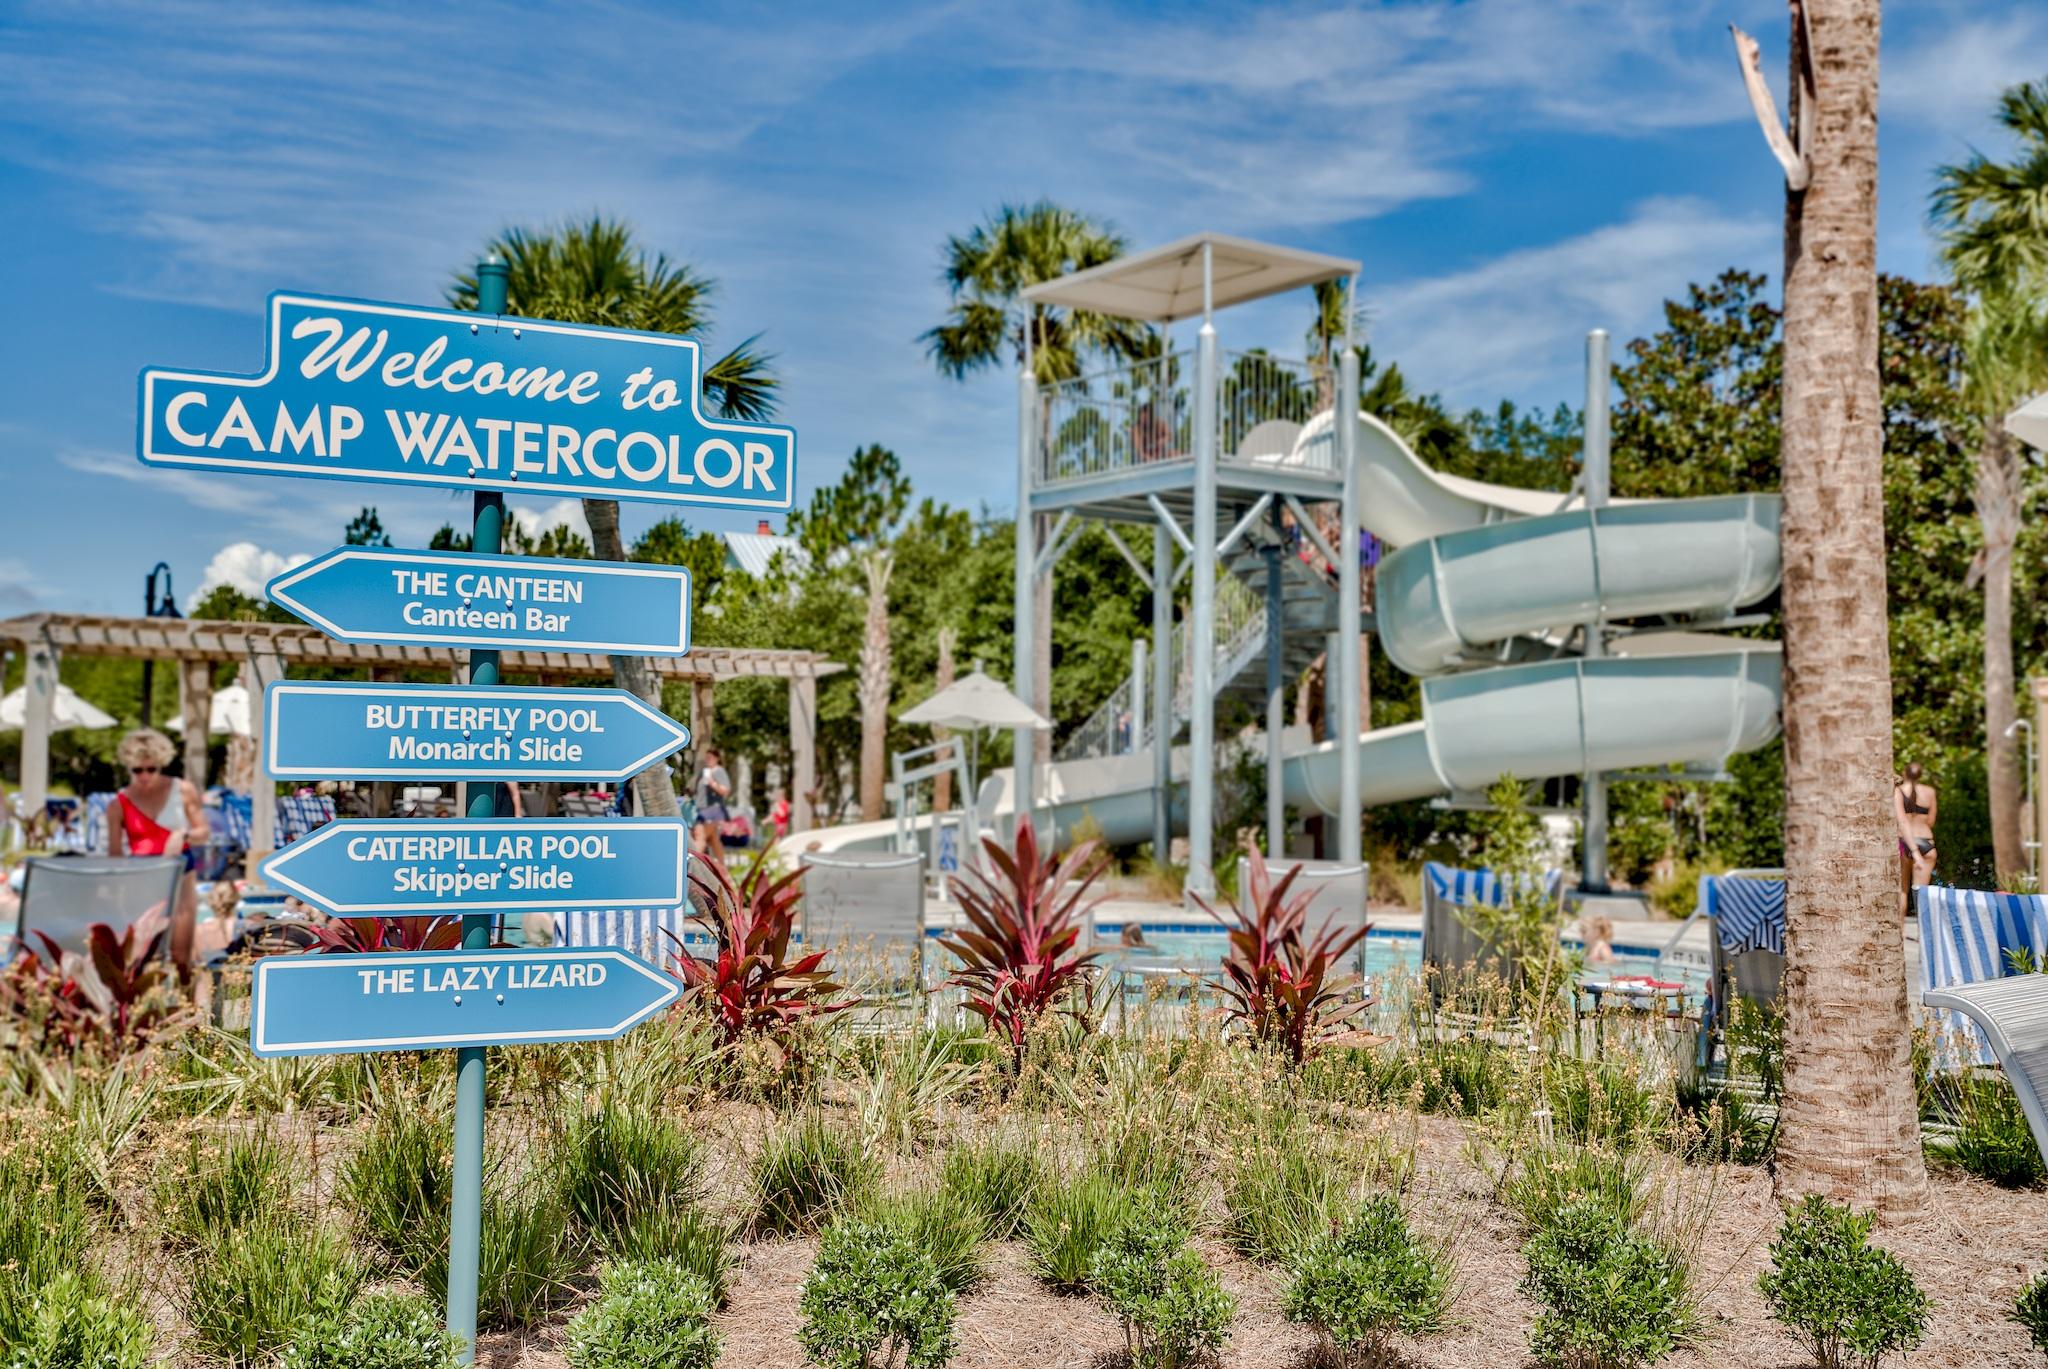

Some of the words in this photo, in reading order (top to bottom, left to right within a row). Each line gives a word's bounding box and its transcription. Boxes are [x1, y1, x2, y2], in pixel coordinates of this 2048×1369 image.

[292, 316, 600, 404] Welcome
[620, 366, 682, 411] to
[165, 391, 364, 457] CAMP
[385, 409, 776, 491] WATERCOLOR
[392, 570, 448, 597] THE
[455, 573, 583, 604] CANTEEN
[403, 601, 517, 629] Canteen
[525, 607, 571, 632] Bar
[366, 704, 522, 731] BUTTERFLY
[529, 708, 604, 733] POOL
[389, 736, 511, 760] Monarch
[519, 737, 583, 762] Slide
[347, 836, 533, 861] CATERPILLAR
[541, 835, 617, 859] POOL
[393, 867, 502, 896] Skipper
[508, 864, 574, 890] Slide
[358, 970, 415, 995] THE
[423, 966, 501, 992] LAZY
[507, 963, 607, 989] LIZARD
